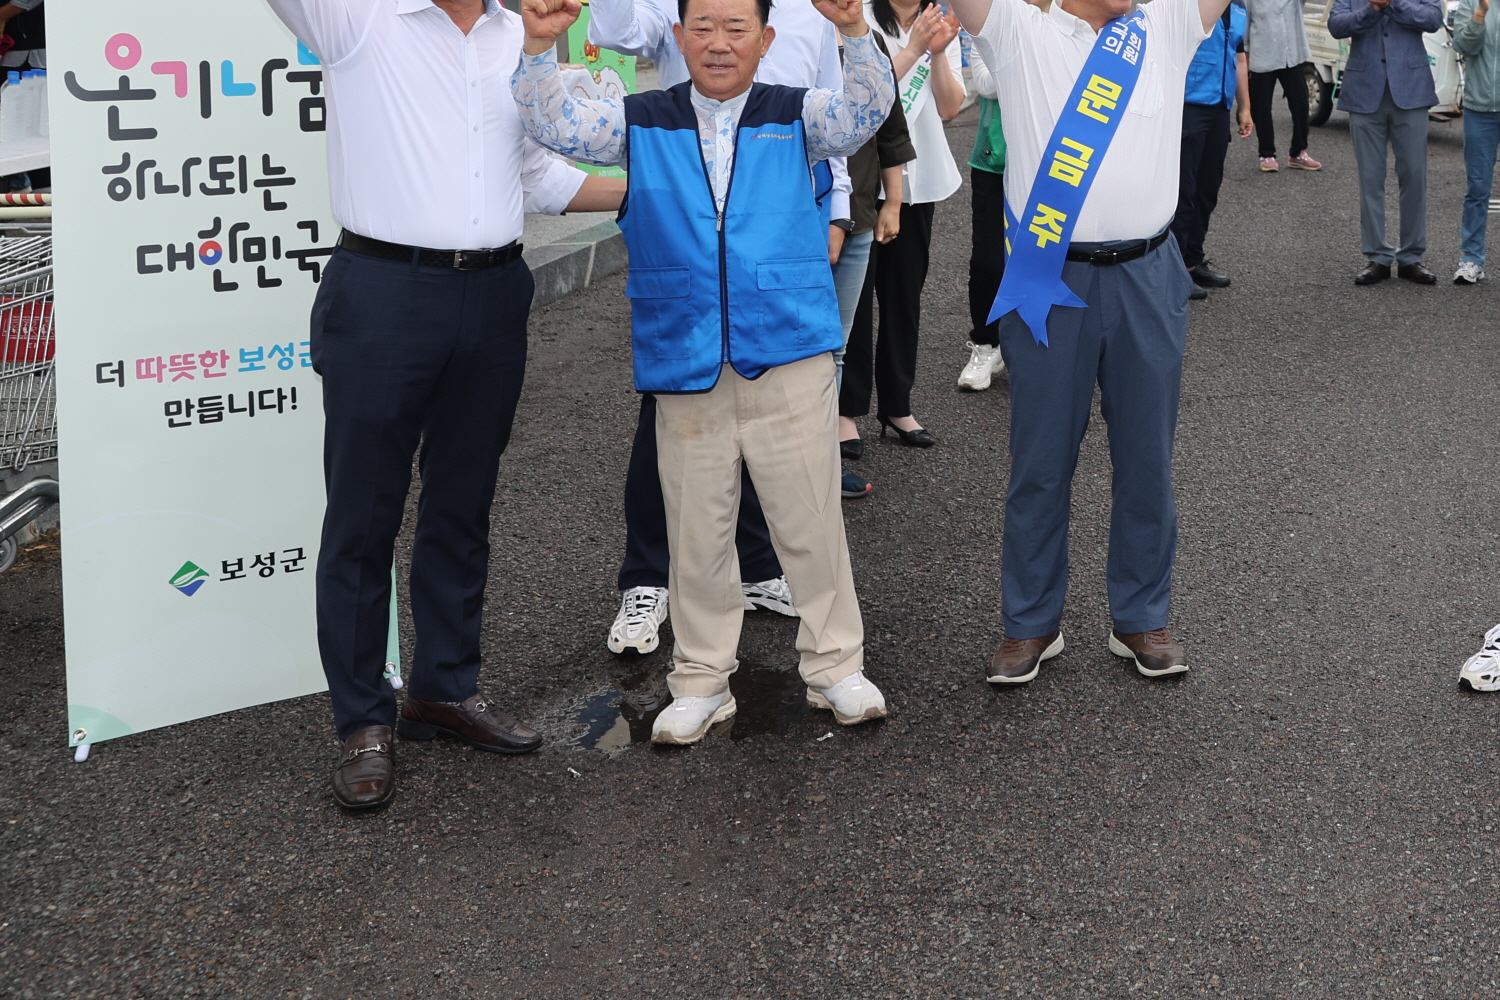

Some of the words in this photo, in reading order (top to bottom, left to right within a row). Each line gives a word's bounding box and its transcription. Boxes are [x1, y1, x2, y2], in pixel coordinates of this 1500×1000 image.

[64, 33, 326, 141] 온기나눔
[101, 152, 296, 211] 하나되는
[1029, 73, 1123, 249] 문금주
[136, 216, 336, 292] 대한민국
[95, 360, 125, 388] 더
[135, 349, 229, 383] 따뜻한
[164, 387, 298, 428] 만듭니다!
[219, 546, 307, 583] 보성군
